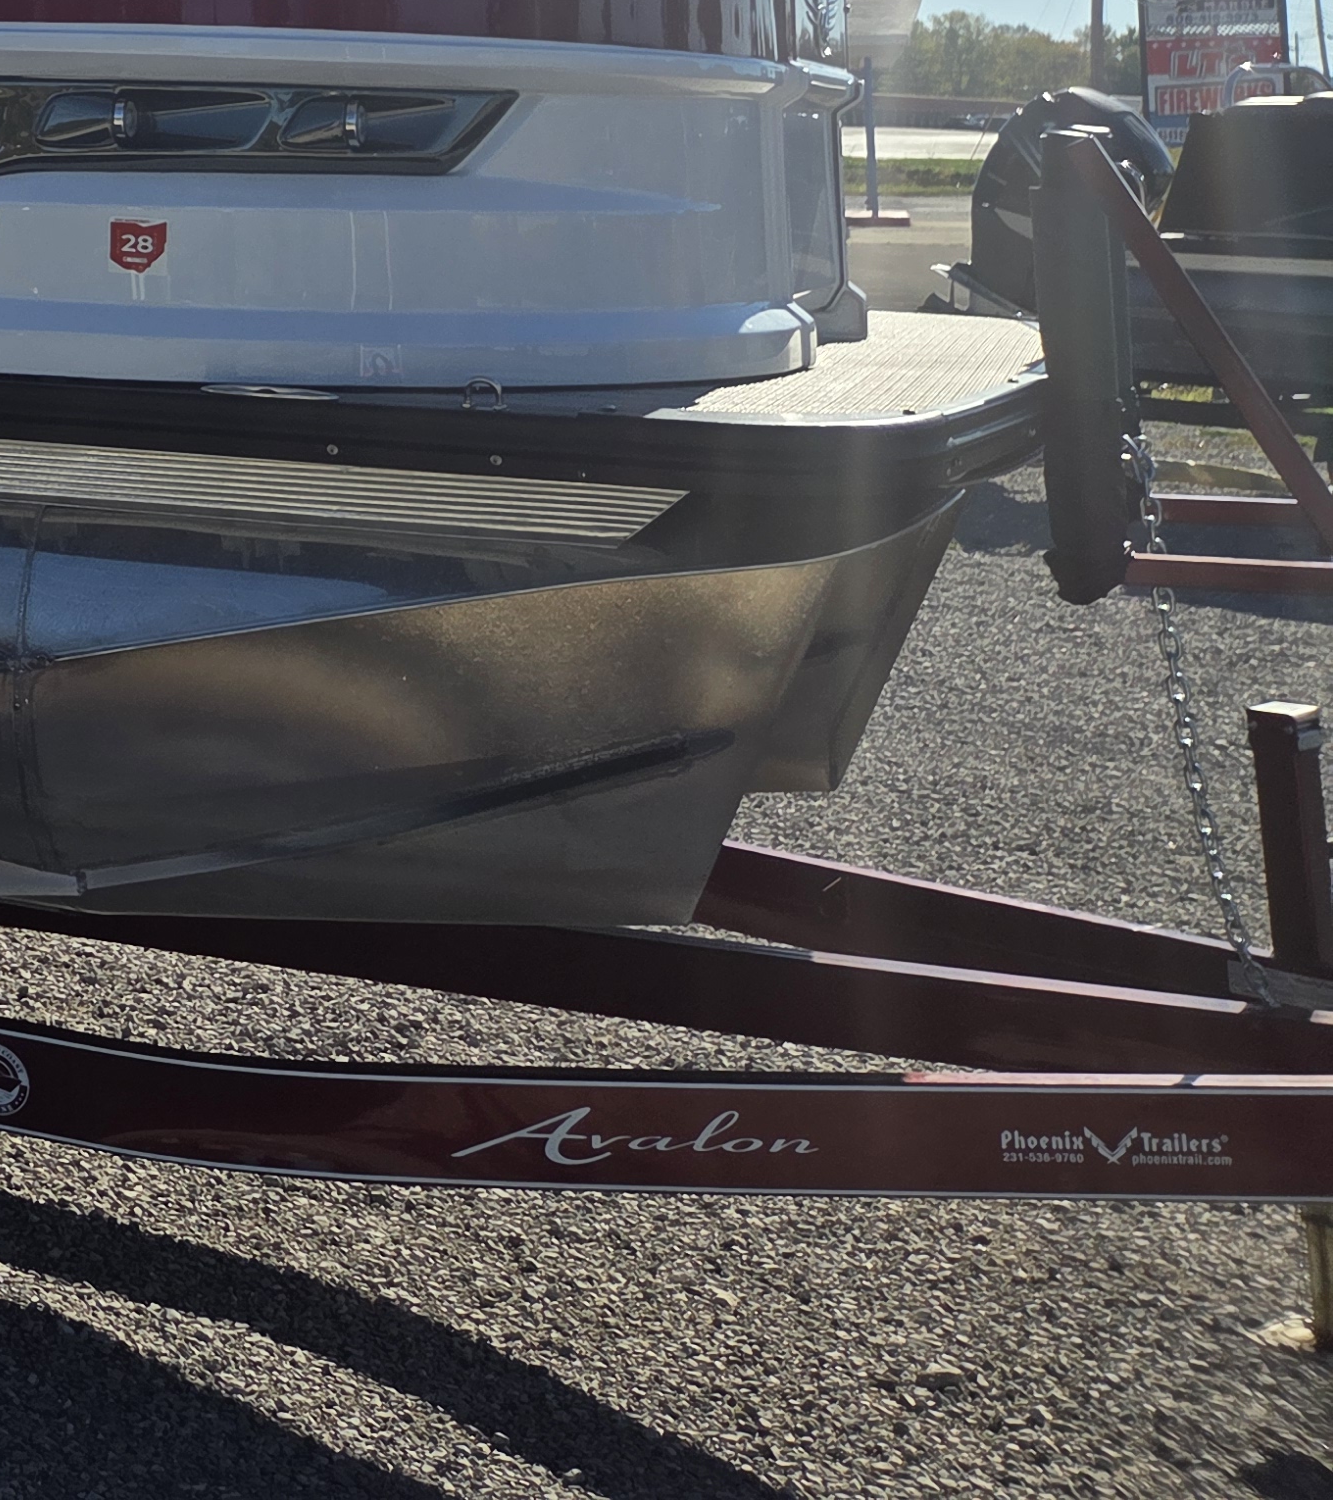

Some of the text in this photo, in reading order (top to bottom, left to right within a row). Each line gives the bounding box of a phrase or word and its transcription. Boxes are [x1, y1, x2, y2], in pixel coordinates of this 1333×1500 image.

[1157, 80, 1274, 116] FIREWRKS
[121, 234, 154, 253] 28
[451, 1106, 819, 1165] Avalon
[1001, 1129, 1084, 1149] Phoenix
[1132, 1153, 1233, 1167] phoenixtrail.com
